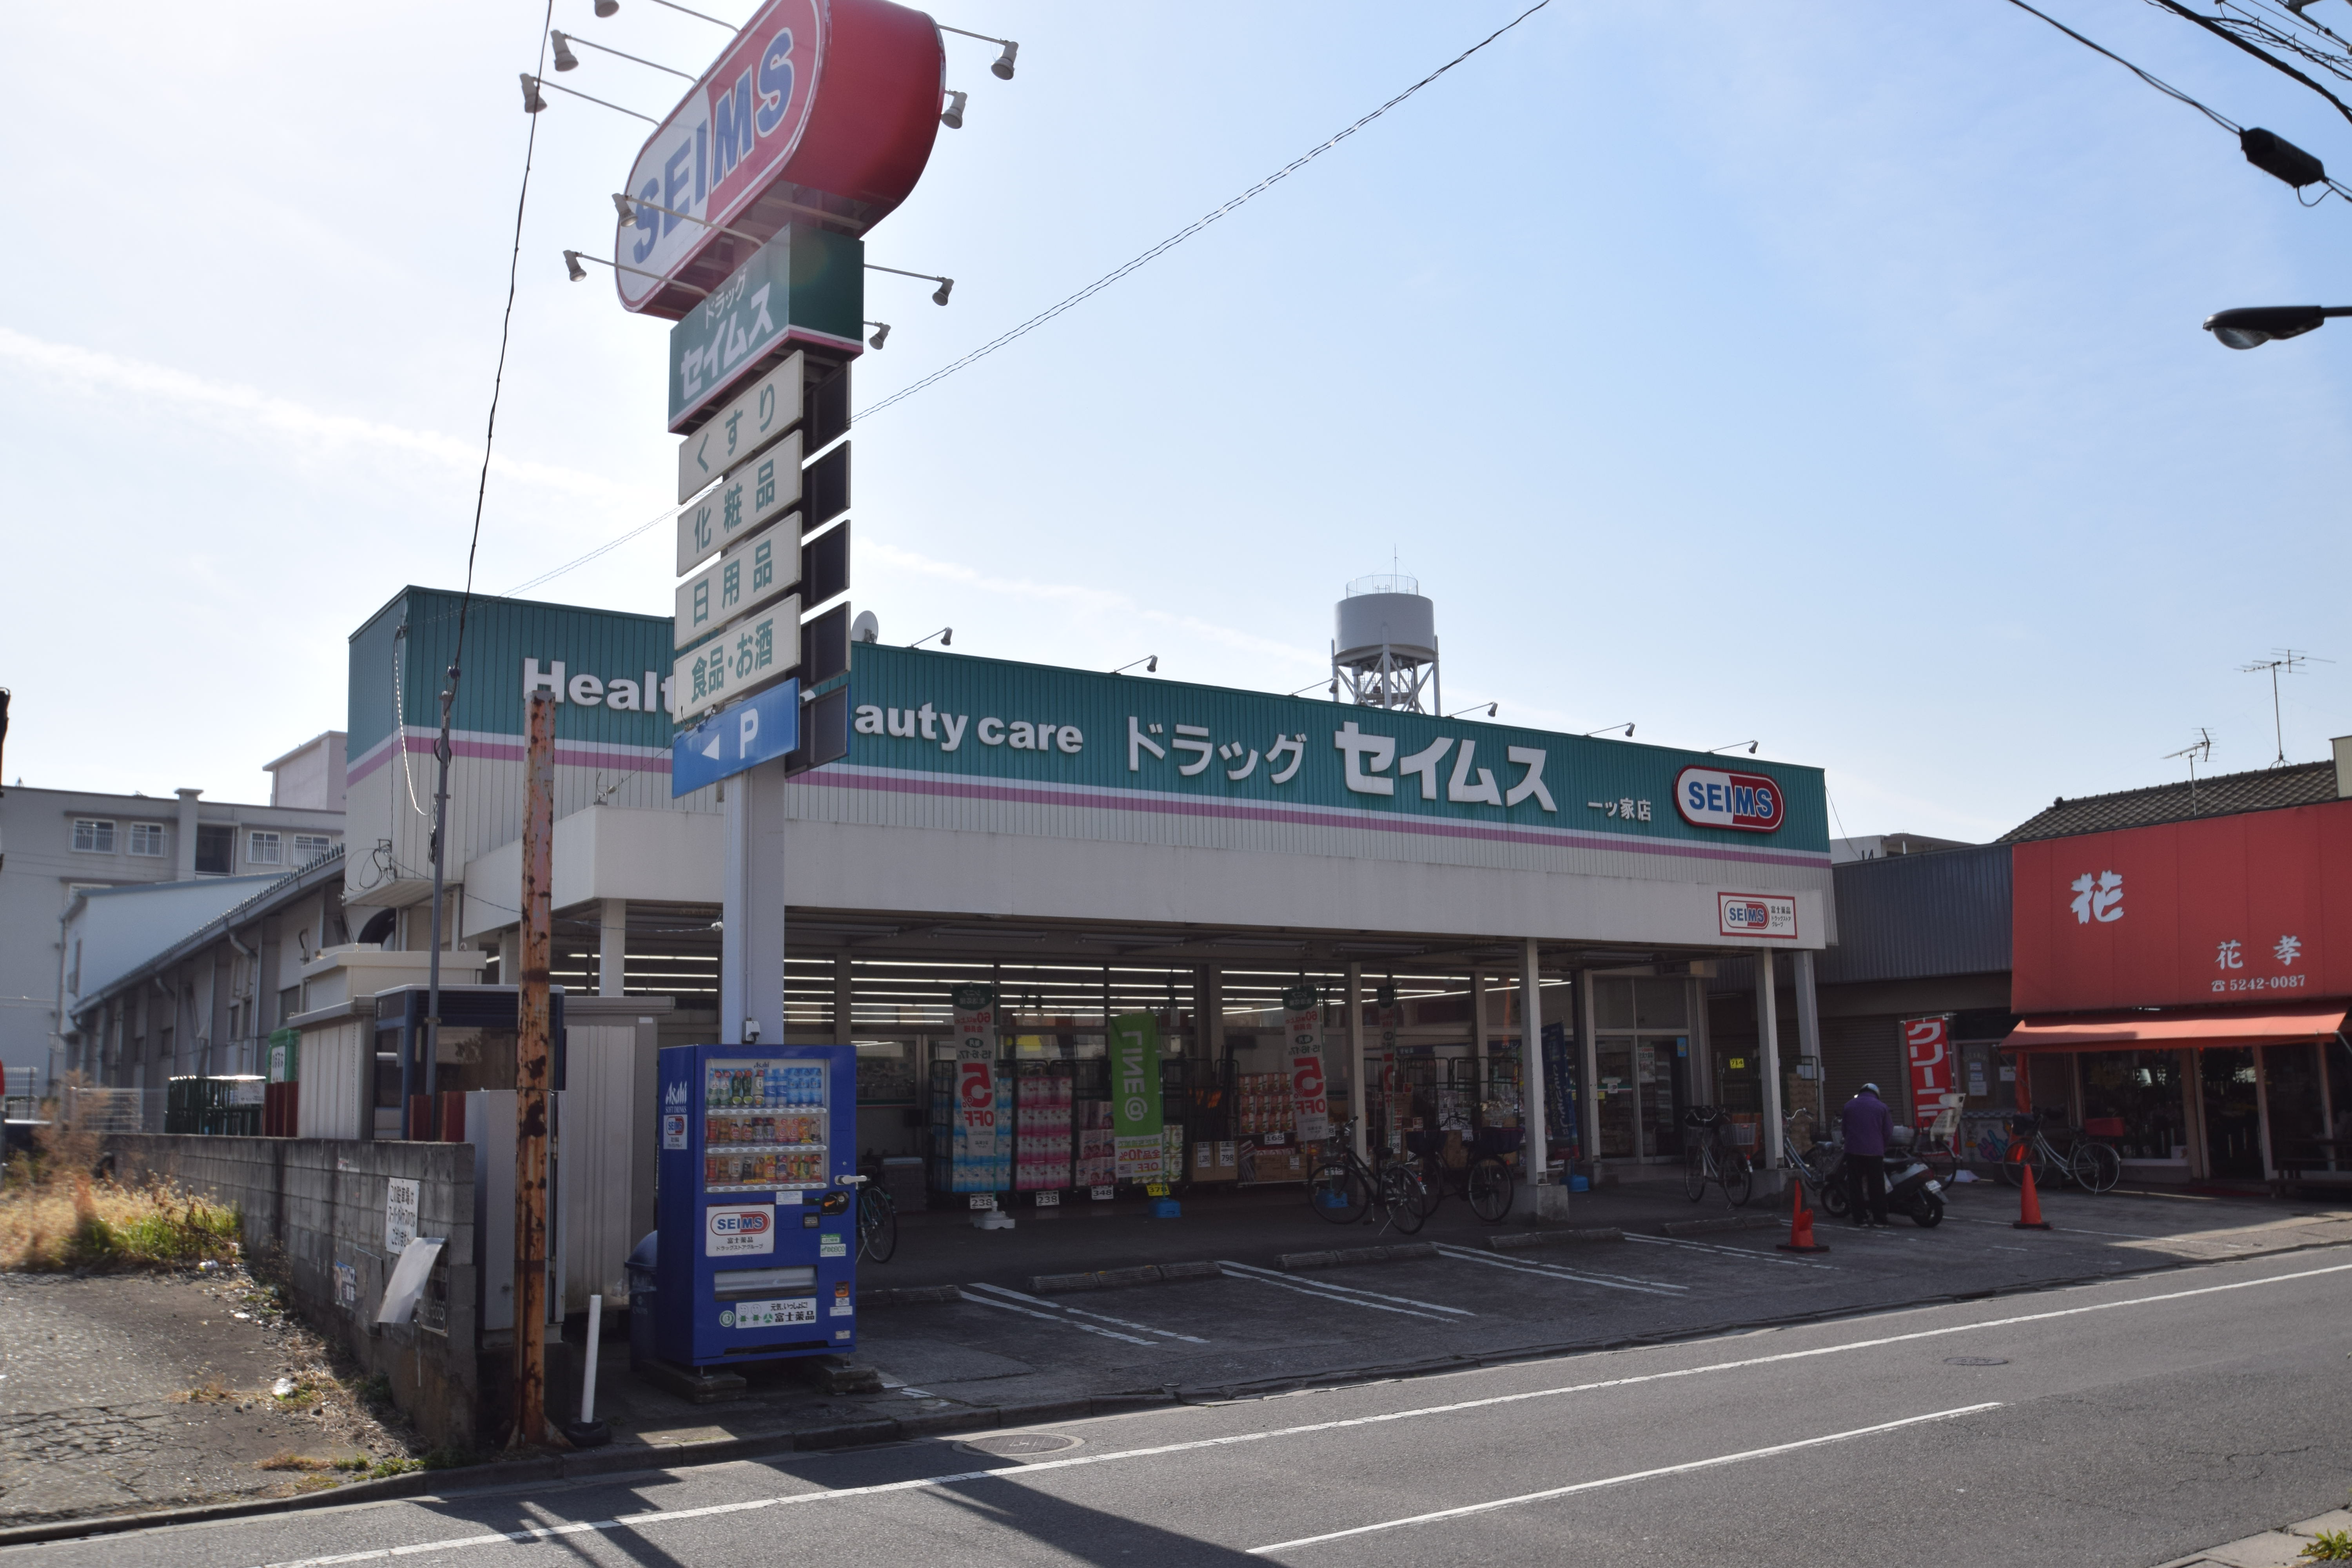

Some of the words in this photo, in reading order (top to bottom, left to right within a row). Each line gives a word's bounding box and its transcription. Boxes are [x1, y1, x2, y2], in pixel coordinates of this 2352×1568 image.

[633, 27, 794, 264] SEIMS
[706, 267, 746, 329] ドラッグ
[681, 282, 774, 400] セイムス
[697, 383, 775, 474] くすり
[695, 458, 775, 554] 化粧品
[693, 539, 773, 628] 日用品
[691, 618, 773, 704] 食品・お酒
[740, 708, 759, 759] P
[977, 717, 1083, 753] care
[1128, 716, 1307, 784] ドラッグ
[1334, 721, 1557, 812] セイムス
[1587, 798, 1651, 822] 一ツ家店
[1688, 781, 1774, 819] SEIMS
[1729, 907, 1764, 923] SEIMS
[1771, 906, 1791, 914] 富士薬品
[2070, 869, 2124, 924] 花
[2230, 975, 2306, 991] 5242-0087
[665, 1080, 687, 1105] Asahi
[1908, 1022, 1952, 1131] クリーニ
[717, 1216, 764, 1230] SEIMS
[775, 1310, 815, 1323] 富士薬品
